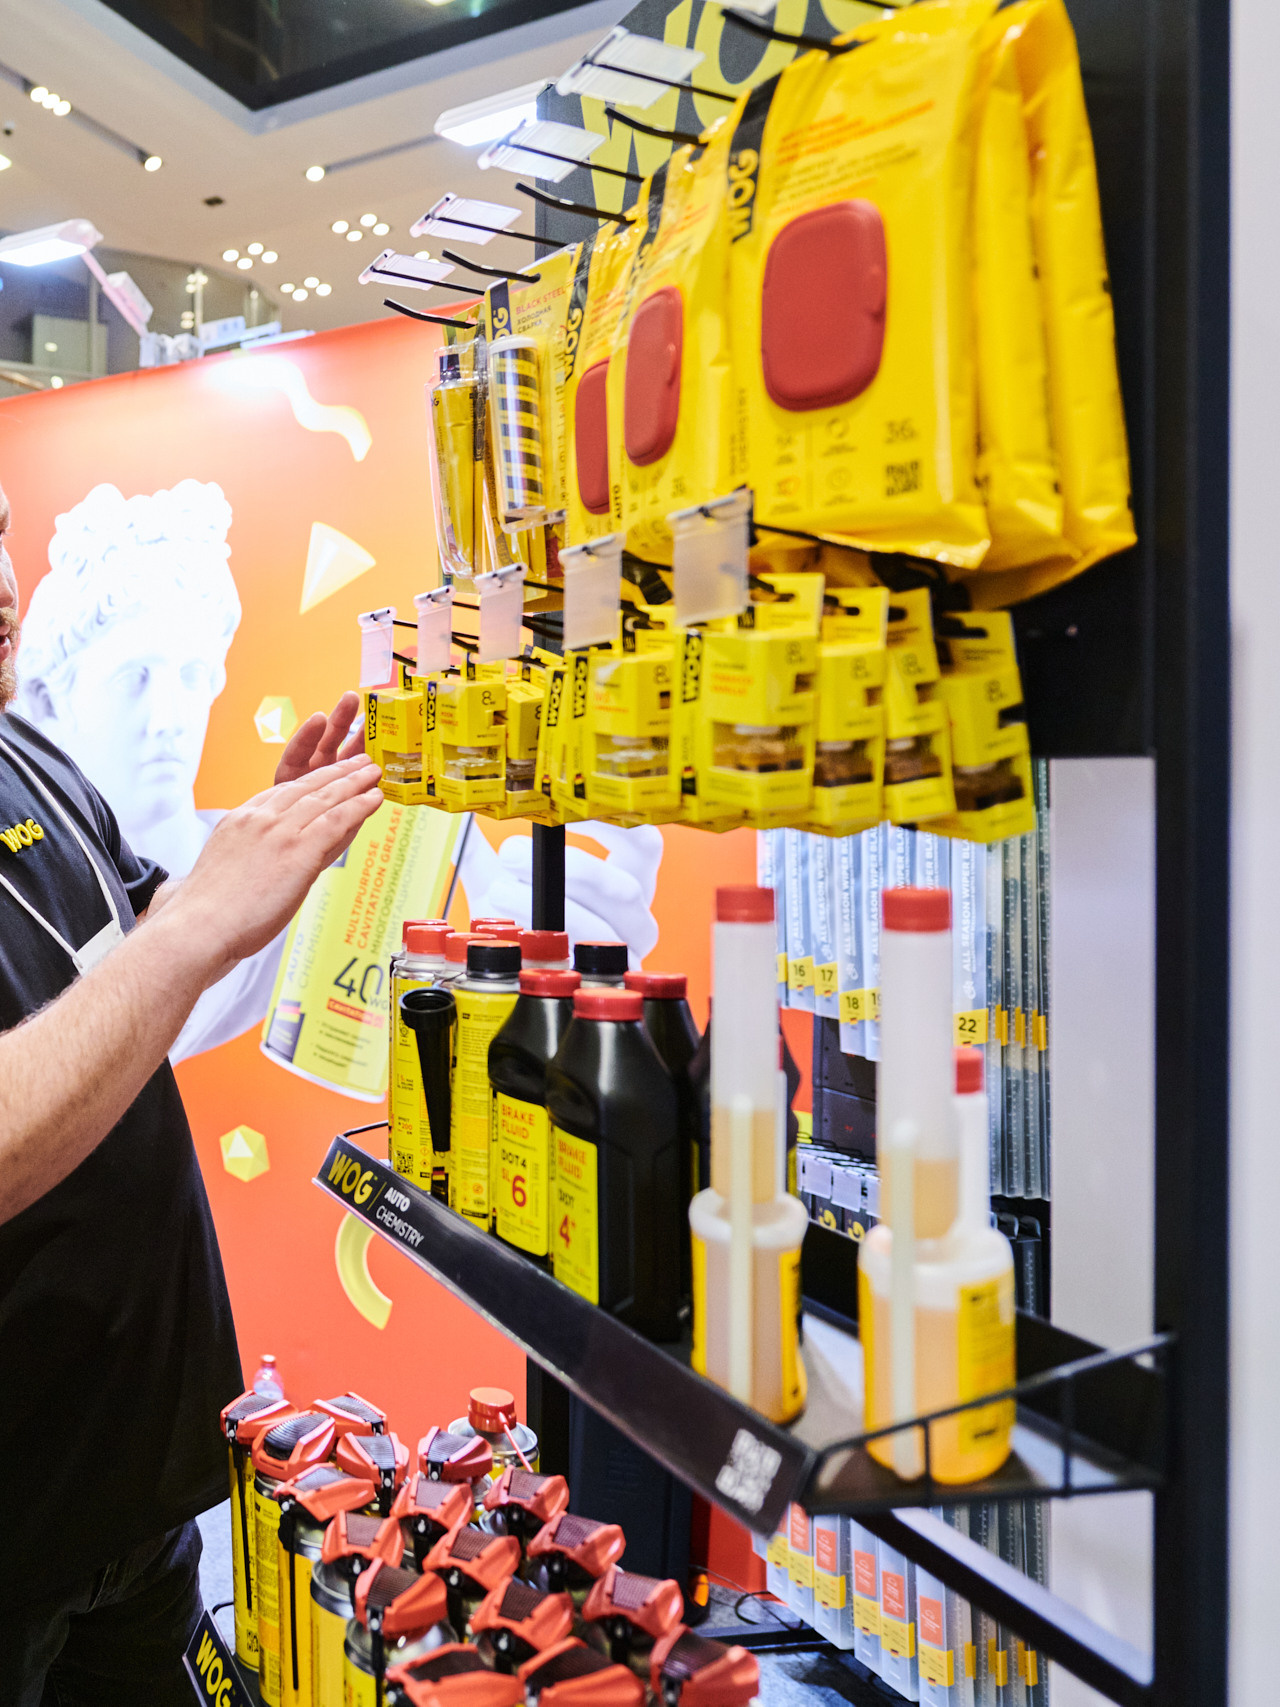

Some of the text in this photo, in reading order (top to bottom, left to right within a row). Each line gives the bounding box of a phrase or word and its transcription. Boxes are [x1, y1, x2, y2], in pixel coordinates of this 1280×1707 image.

[728, 148, 760, 241] WOG
[515, 287, 566, 315] BLACK STEEL
[369, 698, 377, 740] WOG
[427, 686, 437, 731] WOG
[0, 818, 44, 853] WOG
[357, 807, 402, 949] CAVITATION GREASE
[869, 854, 877, 887] WIPER
[896, 855, 904, 889] WIPER
[960, 860, 969, 898] WIPER
[343, 839, 380, 945] MULTIPURPOSE
[841, 891, 849, 933] SEASON
[961, 900, 969, 946] SEASON
[285, 932, 305, 982] AUTO
[297, 888, 332, 990] CHEMISTRY
[793, 964, 805, 977] 16
[821, 969, 833, 982] 17
[962, 950, 970, 971] ALL
[333, 957, 384, 1005] 40
[846, 996, 859, 1009] 18
[958, 1017, 977, 1033] 22
[501, 1104, 535, 1126] BRAKE
[501, 1119, 529, 1139] FLUID
[328, 1150, 374, 1205] WOG
[512, 1175, 527, 1208] 6
[384, 1187, 411, 1212] AUTO
[376, 1205, 425, 1248] CHEMISTRY
[196, 1629, 233, 1707] WOG
